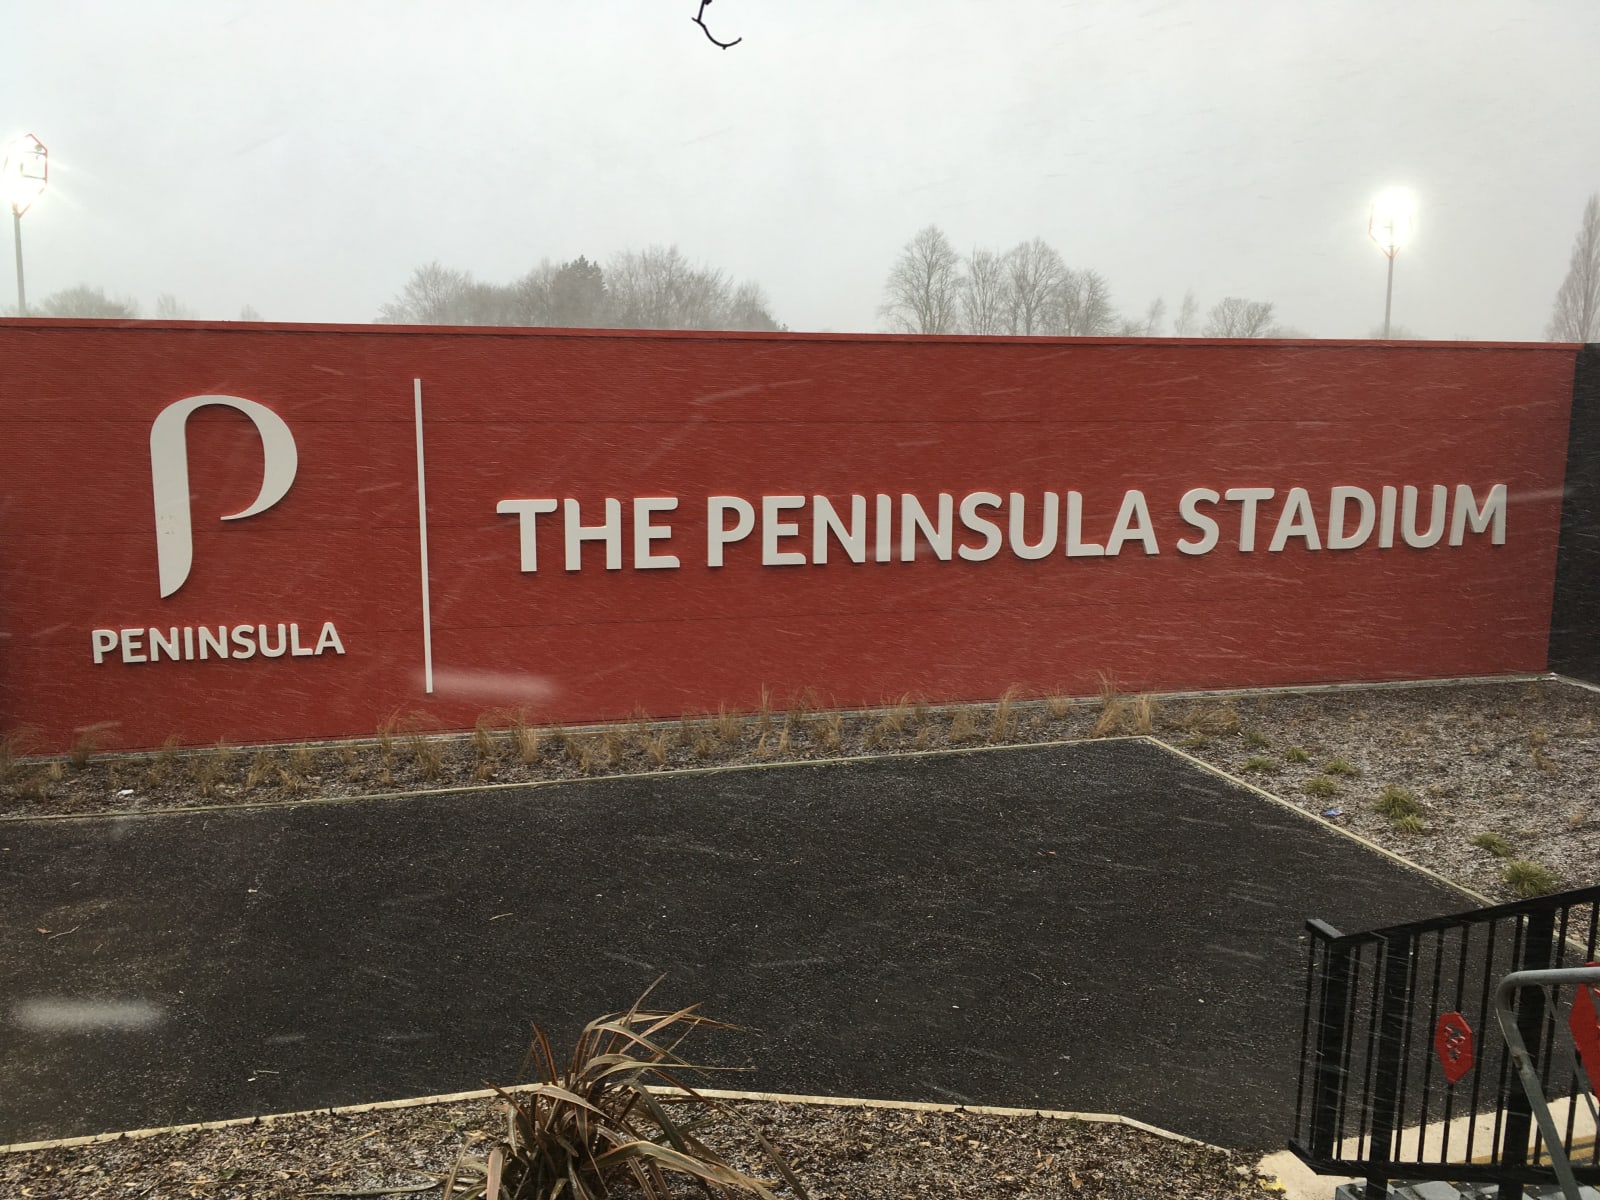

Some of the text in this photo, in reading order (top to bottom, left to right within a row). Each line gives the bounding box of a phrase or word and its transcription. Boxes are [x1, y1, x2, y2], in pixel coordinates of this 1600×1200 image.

[496, 483, 1508, 573] THE PENINSULA STADIUM
[91, 621, 346, 665] PENINSULA
